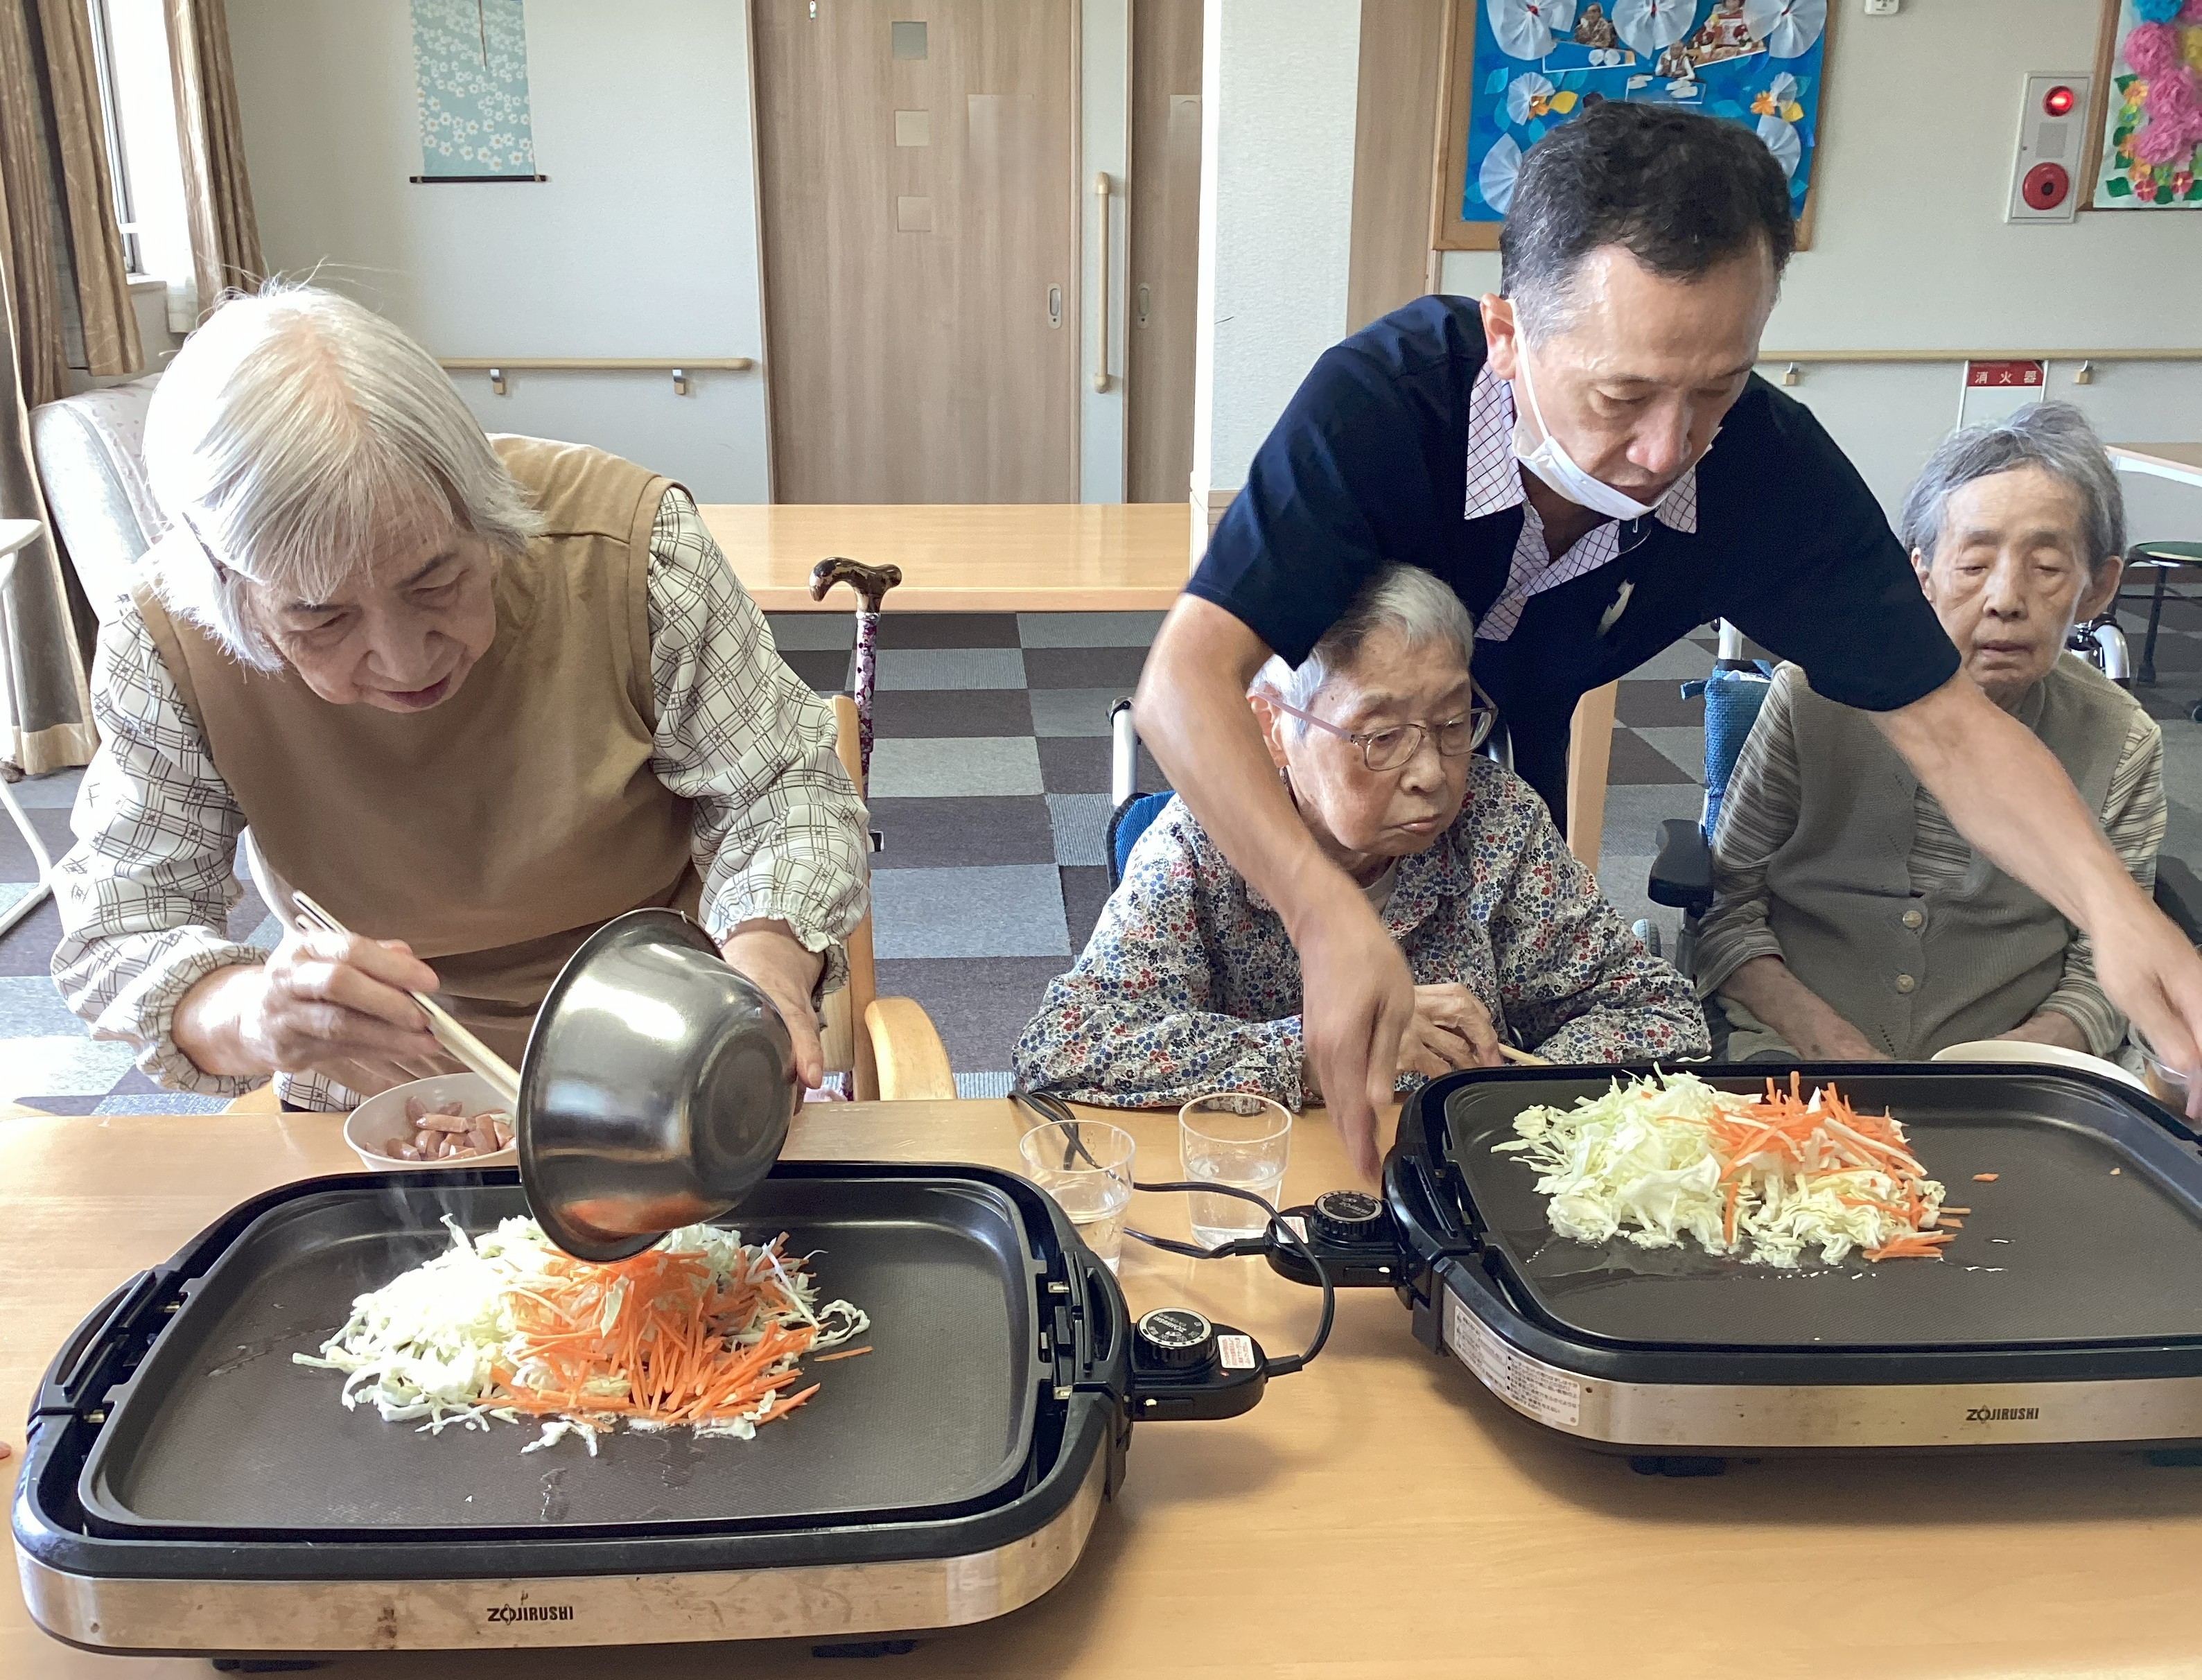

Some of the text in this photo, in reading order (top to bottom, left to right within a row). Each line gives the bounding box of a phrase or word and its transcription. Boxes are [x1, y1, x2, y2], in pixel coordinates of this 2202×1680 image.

[1974, 370, 2037, 384] 消火器
[1966, 1406, 2039, 1423] ZOJIRUSHI
[487, 1604, 574, 1625] ZOJIRUSHI
